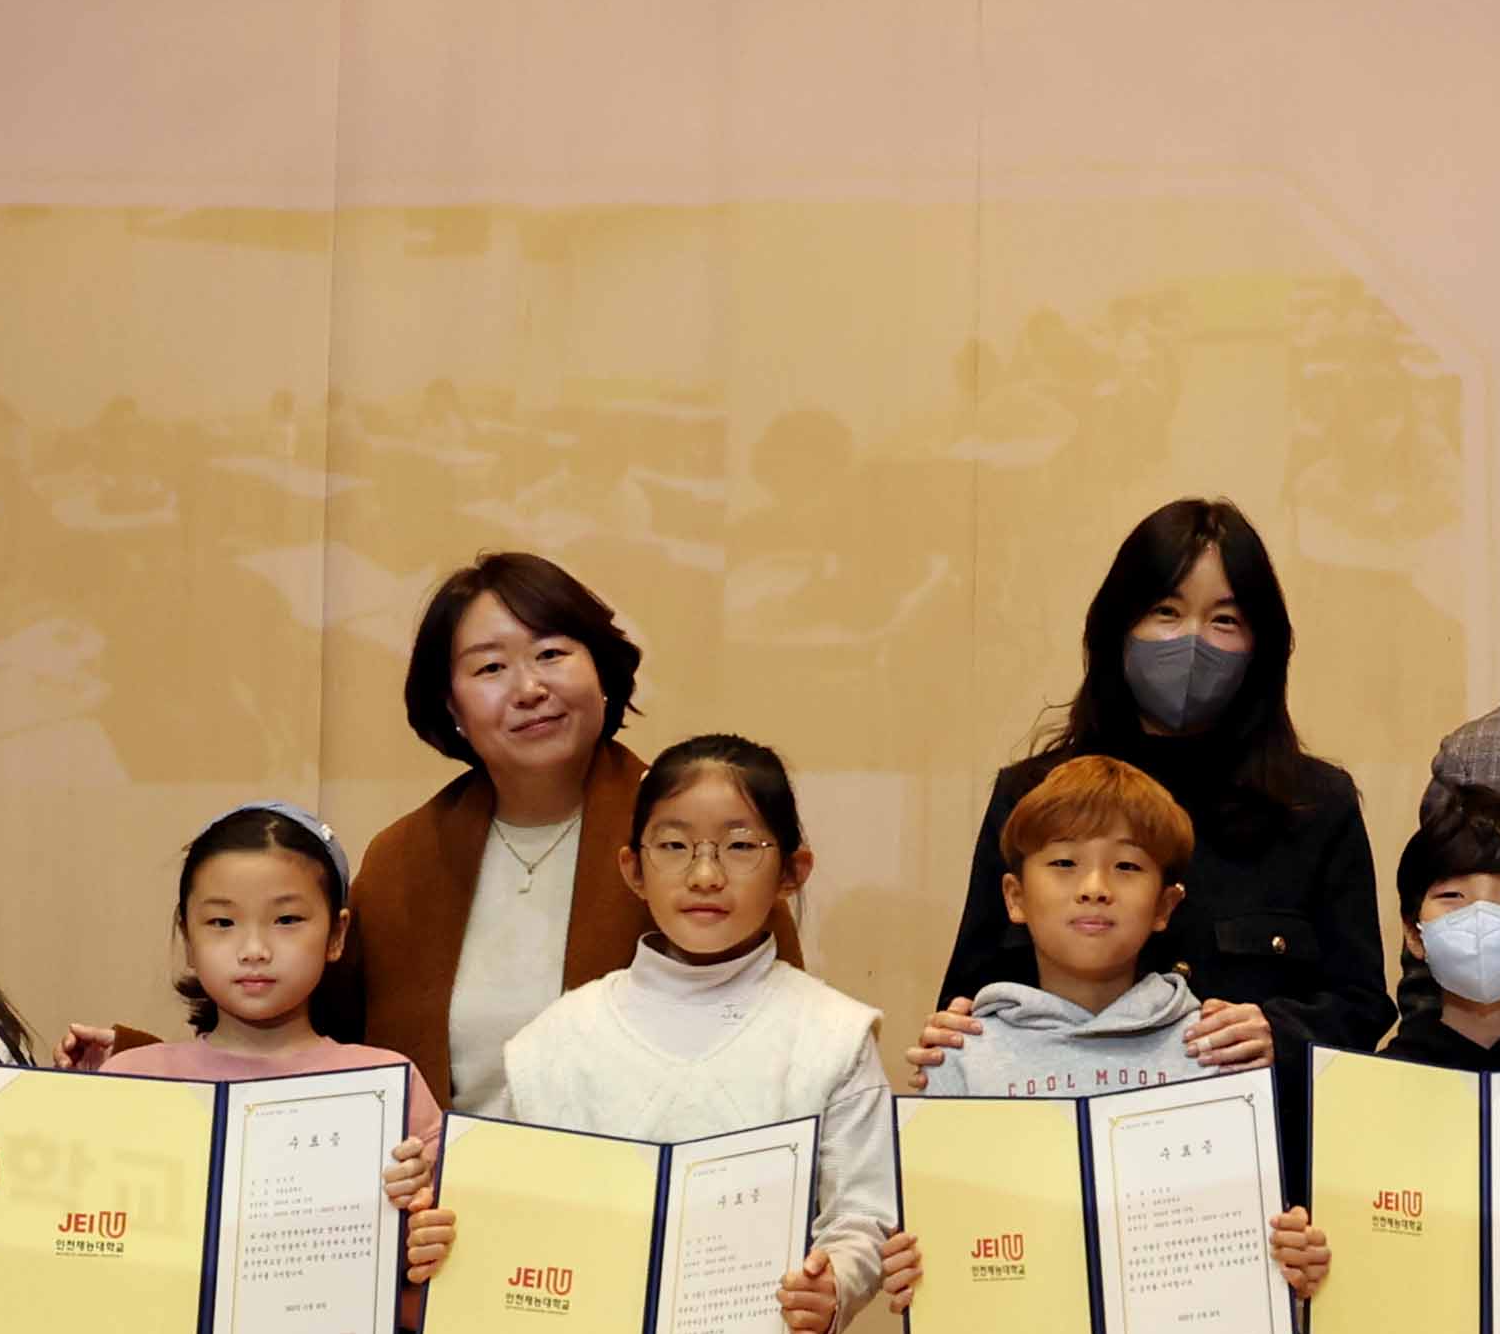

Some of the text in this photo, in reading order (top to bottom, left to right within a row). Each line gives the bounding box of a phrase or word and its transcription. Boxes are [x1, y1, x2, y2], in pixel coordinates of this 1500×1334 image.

[1008, 1069, 1167, 1097] COOL MOOD
[56, 1239, 124, 1253] 인천재능대학교
